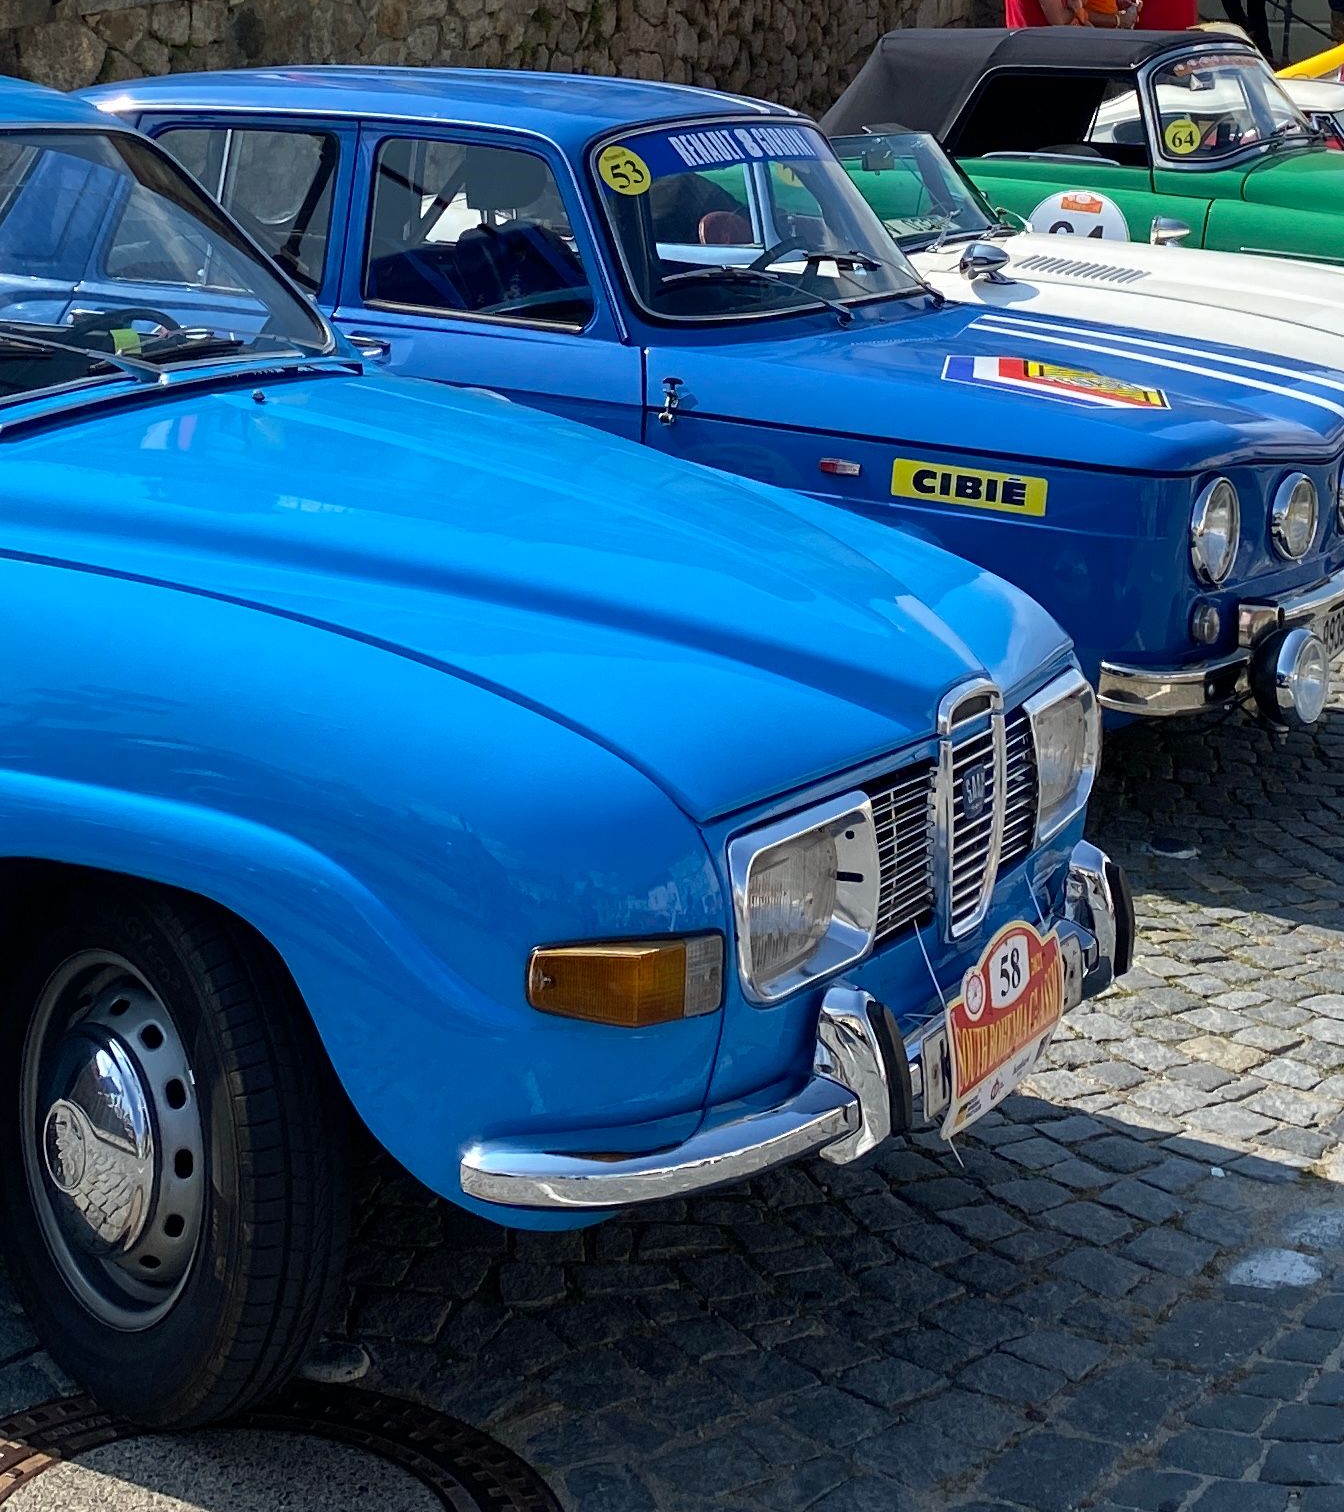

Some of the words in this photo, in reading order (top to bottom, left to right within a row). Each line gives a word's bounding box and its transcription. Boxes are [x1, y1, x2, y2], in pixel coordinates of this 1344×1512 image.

[668, 130, 746, 167] RENAULT
[734, 128, 764, 158] 8
[750, 127, 817, 157] GORDINI
[1172, 130, 1195, 148] 64
[611, 159, 644, 189] 53
[912, 469, 1027, 507] CIBIÉ
[1001, 947, 1021, 997] 58
[957, 1026, 989, 1089] SOUTH
